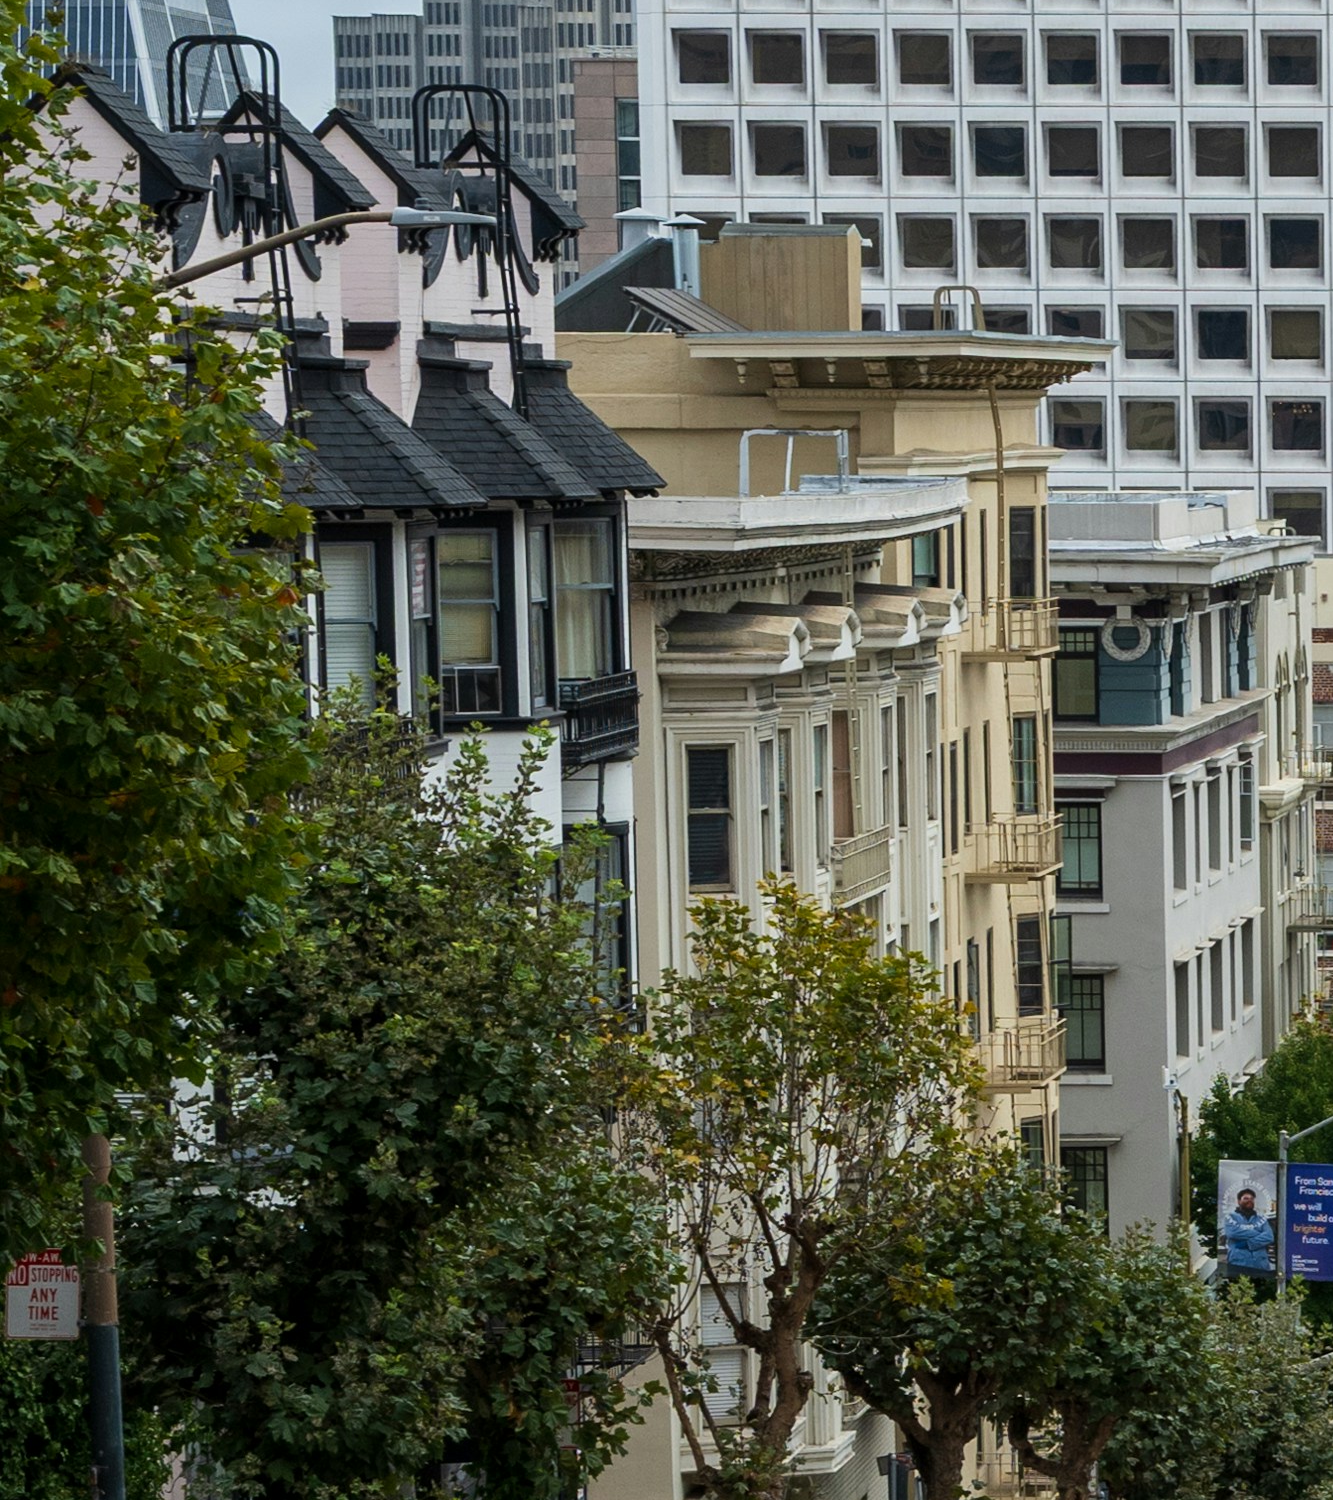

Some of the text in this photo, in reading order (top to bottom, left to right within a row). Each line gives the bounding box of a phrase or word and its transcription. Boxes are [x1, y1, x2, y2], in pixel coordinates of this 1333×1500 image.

[1294, 1175, 1333, 1187] From San
[1293, 1202, 1323, 1211] we will
[1307, 1213, 1328, 1222] build
[1292, 1223, 1326, 1234] brighter
[7, 1265, 79, 1285] NO STOPPING
[30, 1288, 58, 1303] ANY
[28, 1306, 60, 1320] TIME
